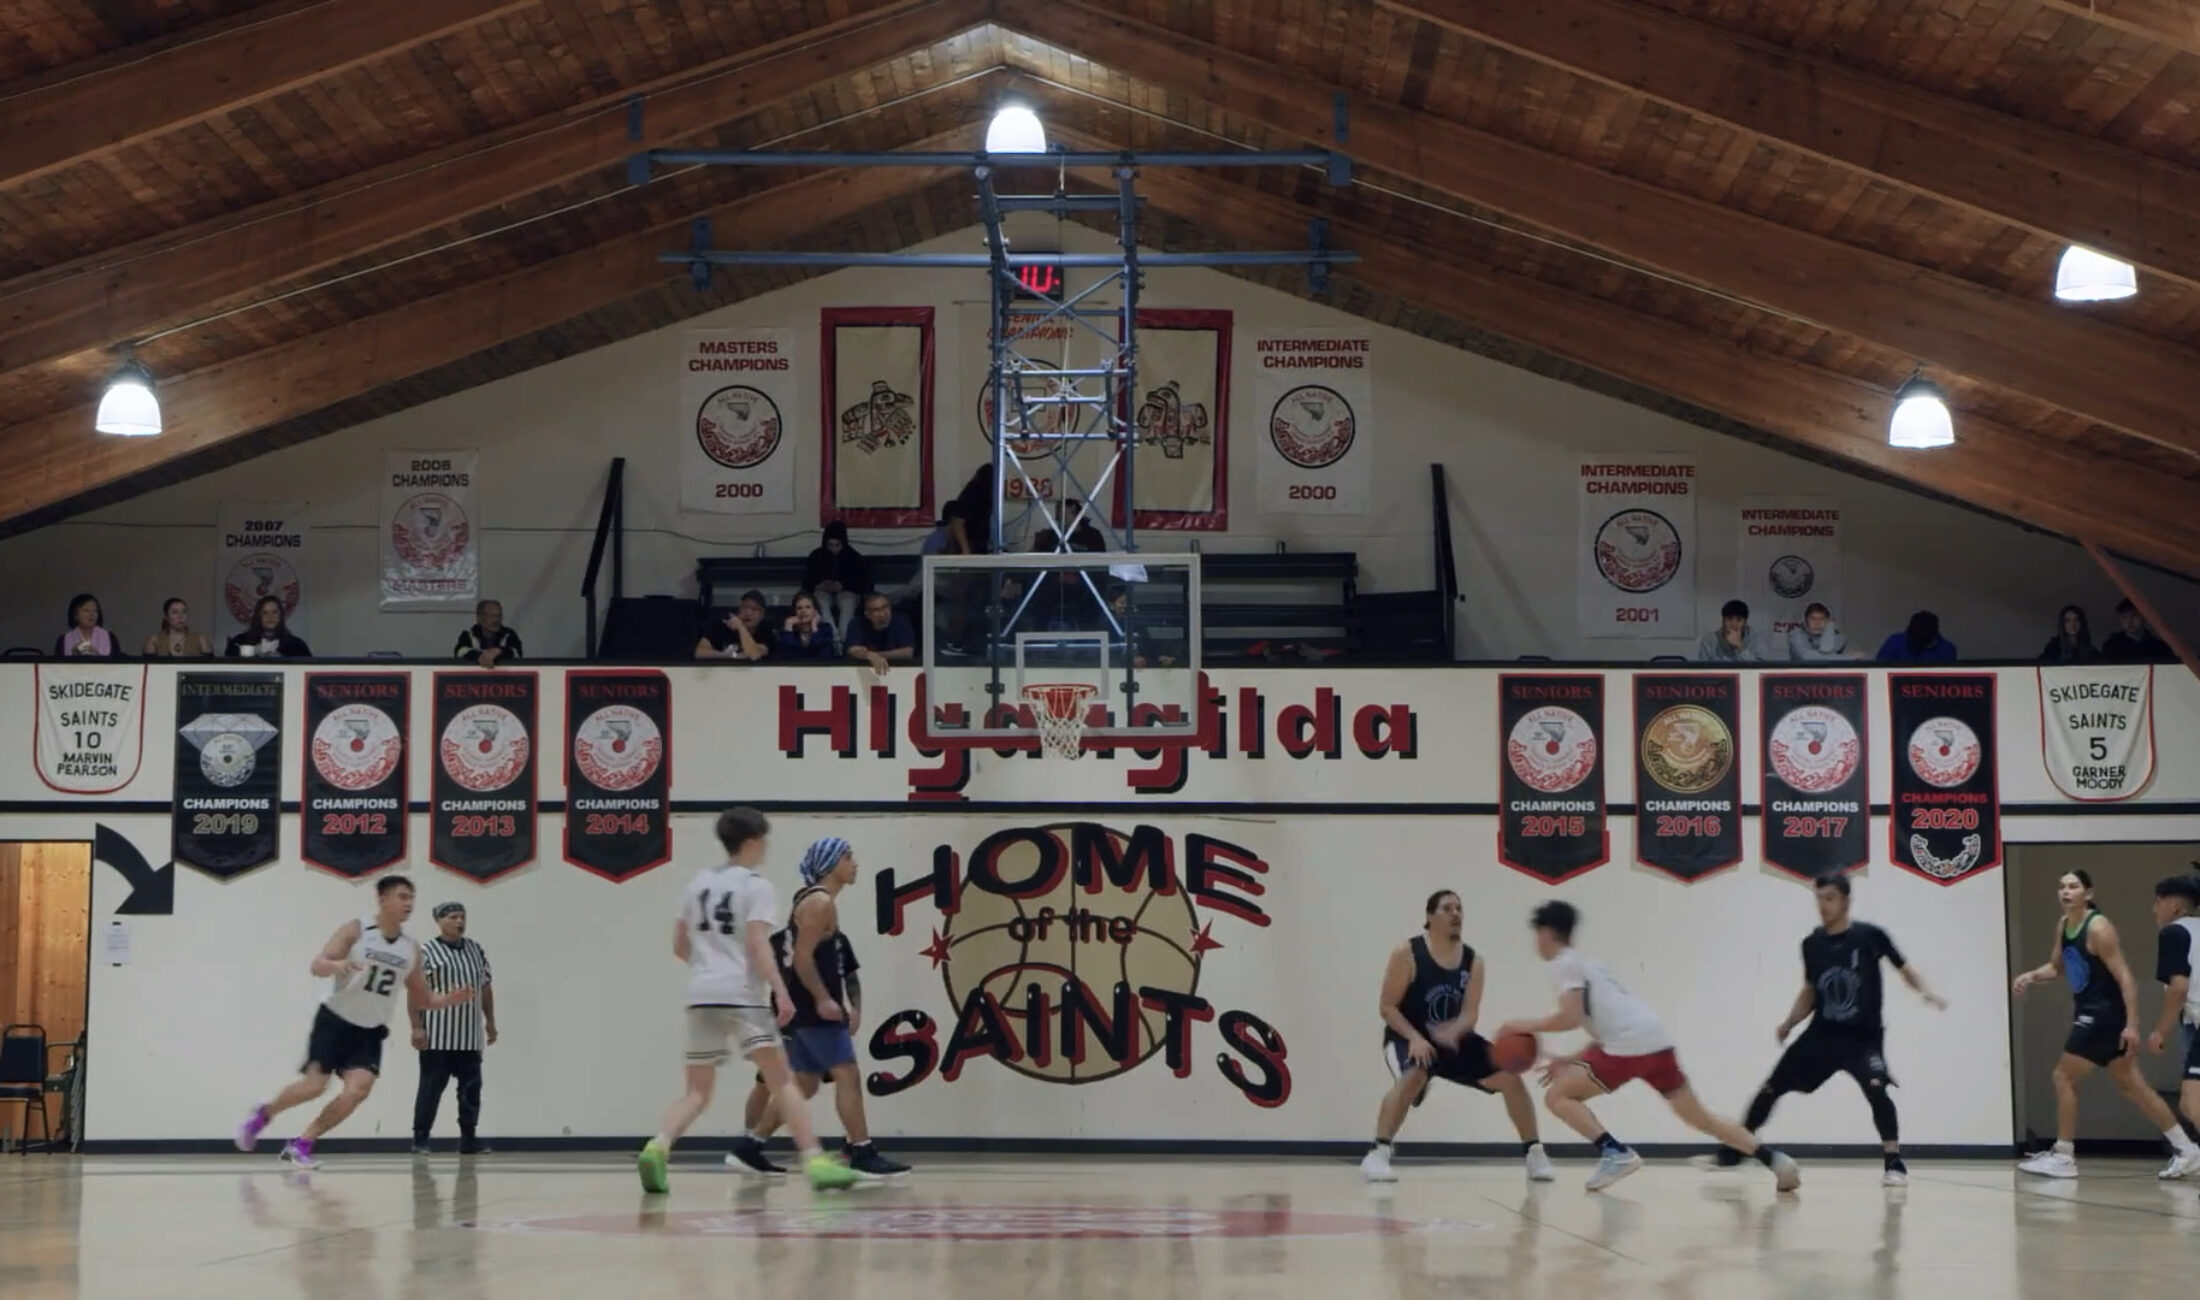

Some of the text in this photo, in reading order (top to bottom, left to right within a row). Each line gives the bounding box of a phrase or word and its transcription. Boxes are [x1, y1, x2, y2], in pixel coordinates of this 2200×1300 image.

[986, 326, 1074, 340] AMPION
[699, 341, 778, 354] MASTERS
[1257, 339, 1370, 352] INTERMEDIATE
[688, 358, 789, 372] CHAMPIONS
[1263, 356, 1364, 368] CHAMPIONS
[1580, 464, 1695, 478] INTERMEDIATE
[392, 473, 470, 487] CHAMPIONS
[715, 484, 764, 499] 2000
[1288, 485, 1337, 500] 2000
[1586, 481, 1689, 495] CHAMPIONS
[1741, 509, 1840, 521] INTERMEDIATE
[245, 520, 284, 532] 2007
[1747, 525, 1835, 537] CHAMPIONS
[226, 534, 301, 548] CHAMPIONS
[1615, 607, 1660, 622] 2001
[49, 681, 133, 702] SKIDEGATE
[182, 683, 279, 697] INTERMEDIATE
[316, 683, 399, 698] SENIORS
[445, 683, 527, 698] SENIORS
[579, 683, 659, 698] SENIORS
[1511, 684, 1593, 698] SENIORS
[1646, 685, 1728, 698] SENIORS
[1772, 684, 1855, 698] SENIORS
[1901, 684, 1984, 698] SENIORS
[2050, 683, 2140, 703] SKIDEGATE
[60, 710, 118, 728] SAINTS
[2068, 713, 2127, 730] SAINTS
[74, 731, 102, 750] 10
[2089, 736, 2108, 761] 5
[62, 752, 113, 764] MARVIN
[56, 763, 118, 777] PEARSON
[2072, 765, 2127, 778] GARNER
[2076, 778, 2125, 790] MOODY
[183, 798, 270, 810] CHAMPIONS
[312, 798, 398, 810] CHAMPIONS
[575, 798, 660, 810] CHAMPIONS
[1901, 792, 1988, 804] CHAMPIONS
[441, 799, 527, 812] CHAMPIONS
[1510, 800, 1596, 812] CHAMPIONS
[1645, 800, 1732, 812] CHAMPIONS
[1772, 801, 1860, 813] CHAMPIONS
[192, 813, 259, 835] 2019
[321, 812, 388, 835] 2012
[451, 814, 516, 837] 2013
[585, 813, 650, 835] 2014
[1911, 808, 1980, 829] 2020
[1521, 815, 1586, 837] 2015
[1656, 815, 1722, 837] 2016
[1783, 816, 1849, 838] 2017
[875, 822, 1272, 936] HOME
[697, 888, 735, 935] 14
[1008, 906, 1137, 945] of the
[363, 965, 397, 997] 12
[867, 978, 1292, 1108] SAINTS
